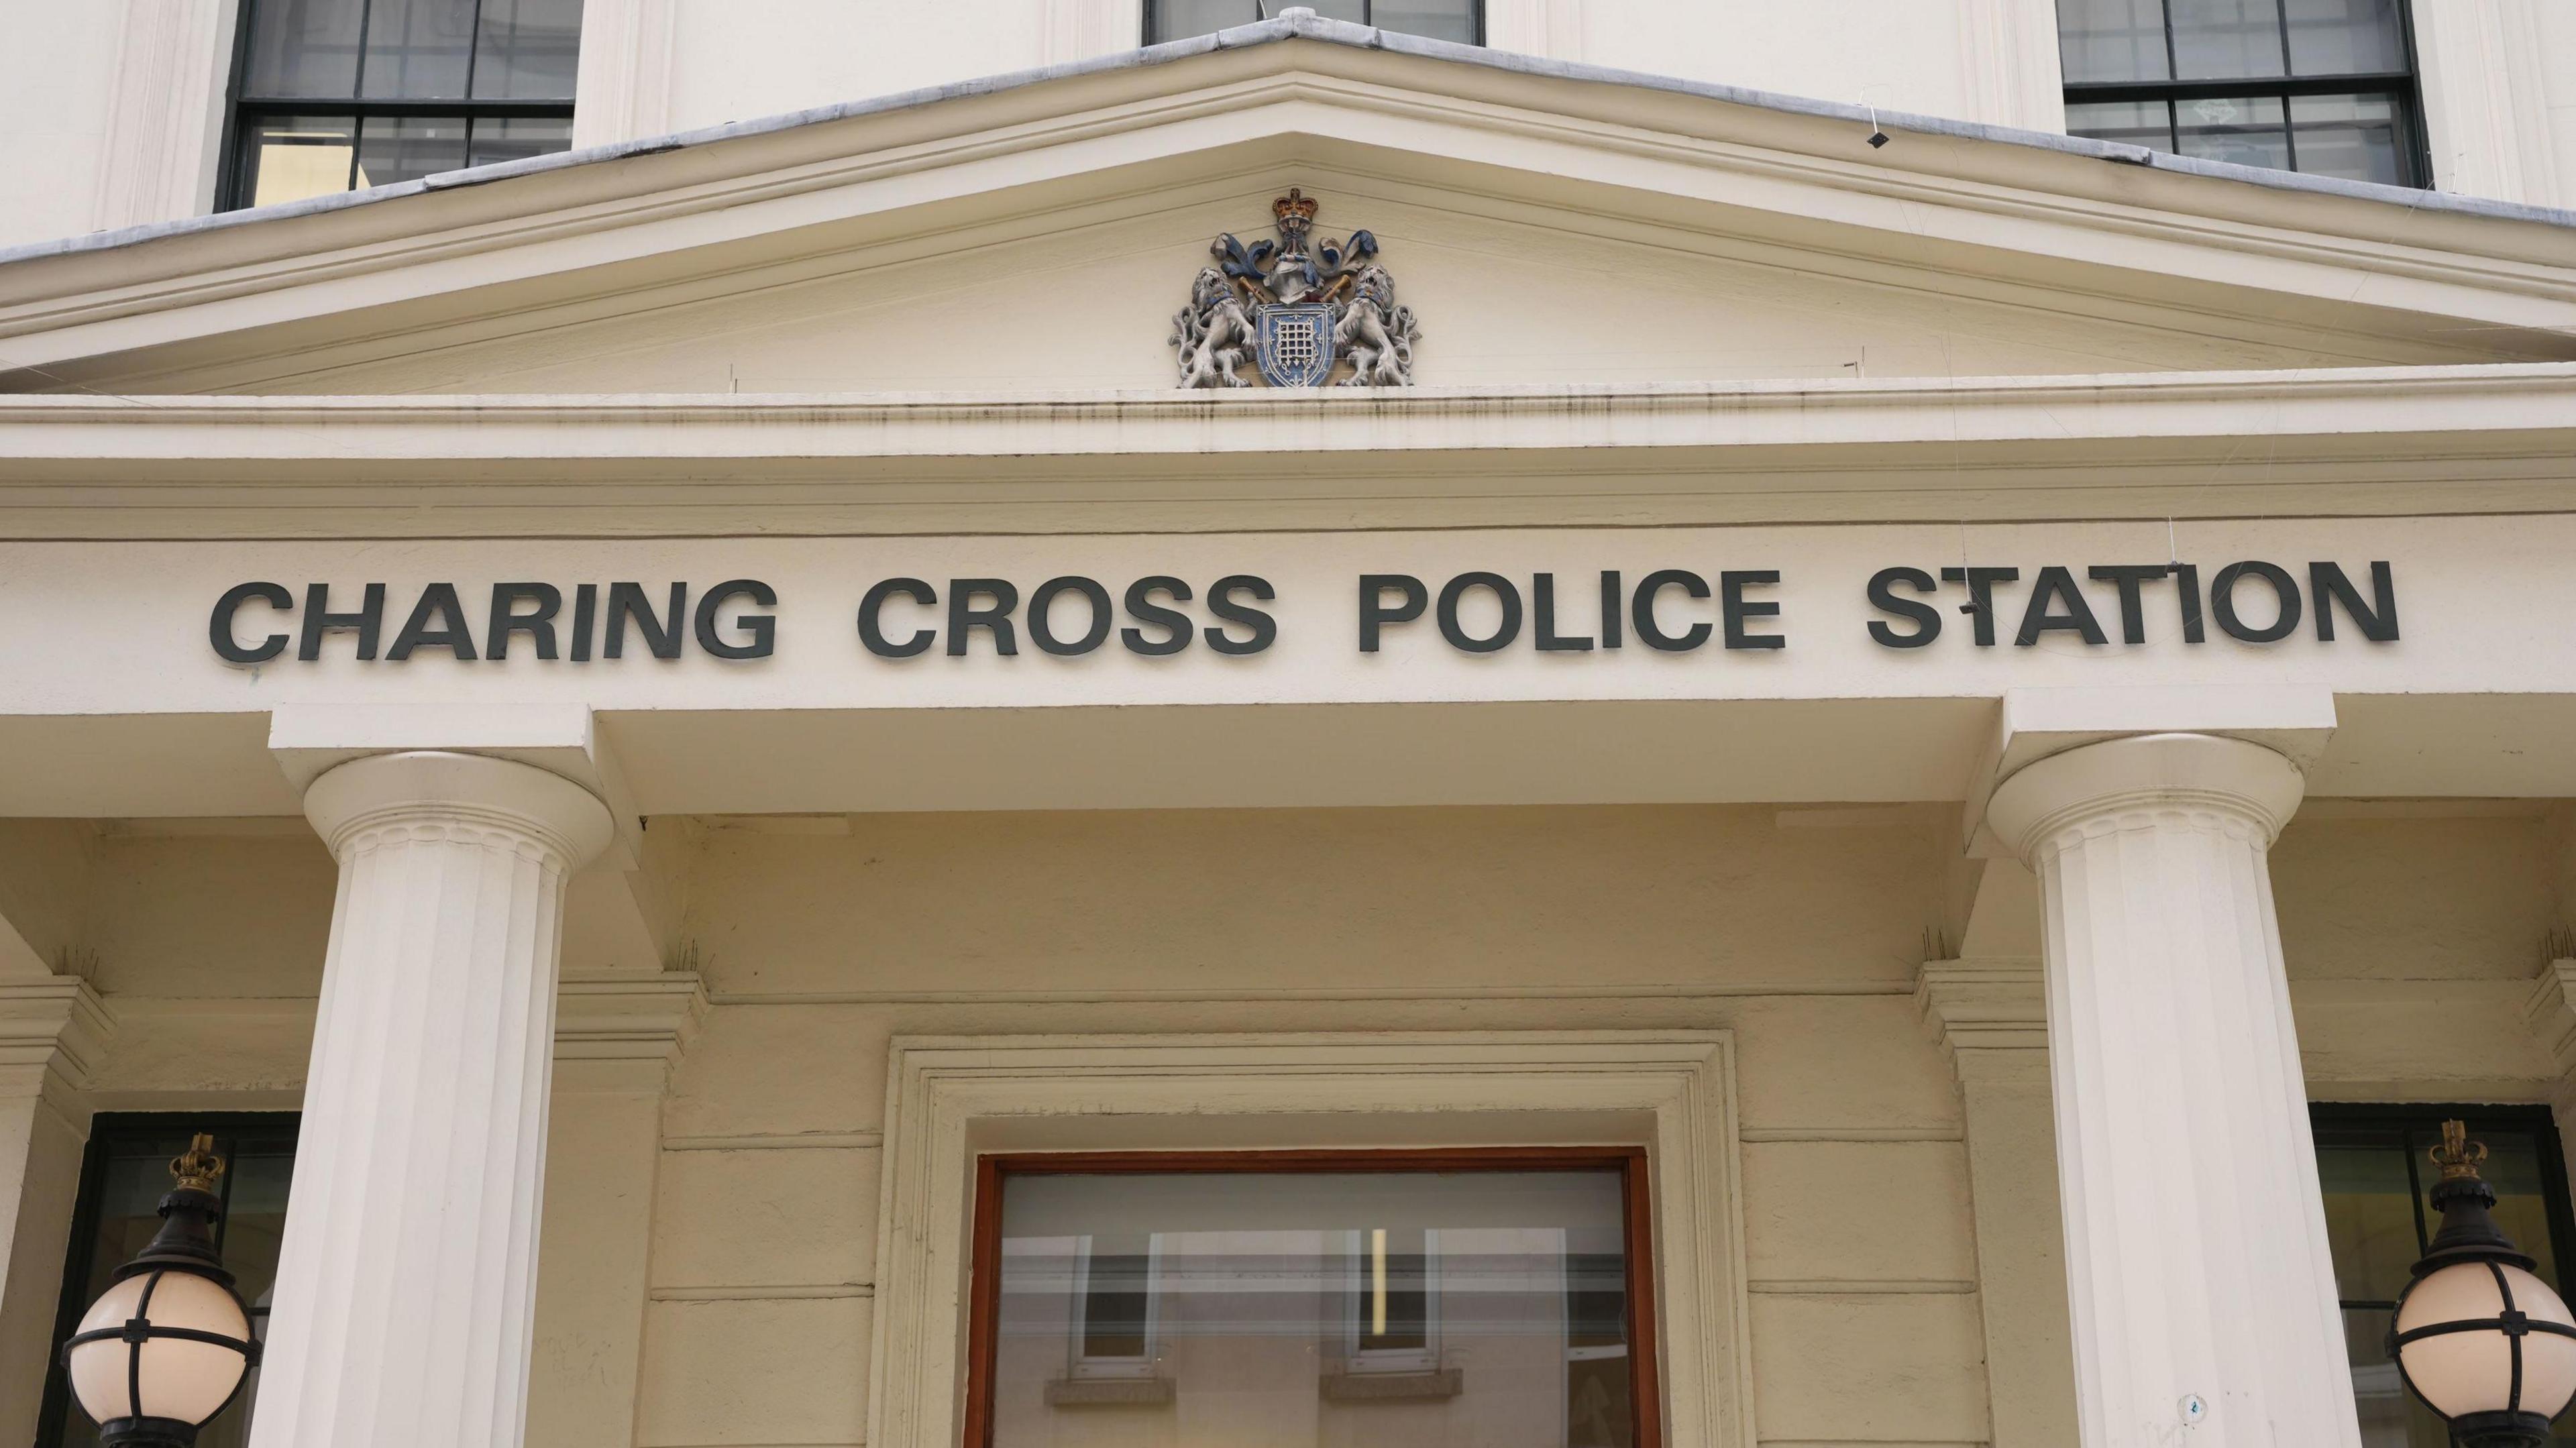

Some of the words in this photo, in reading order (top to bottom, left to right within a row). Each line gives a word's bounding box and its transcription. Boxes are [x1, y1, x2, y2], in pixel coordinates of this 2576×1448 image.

[209, 579, 777, 664] CHARING
[857, 575, 1277, 658] CROSS
[1359, 569, 1786, 653] POLICE
[1866, 561, 2400, 649] STATION
